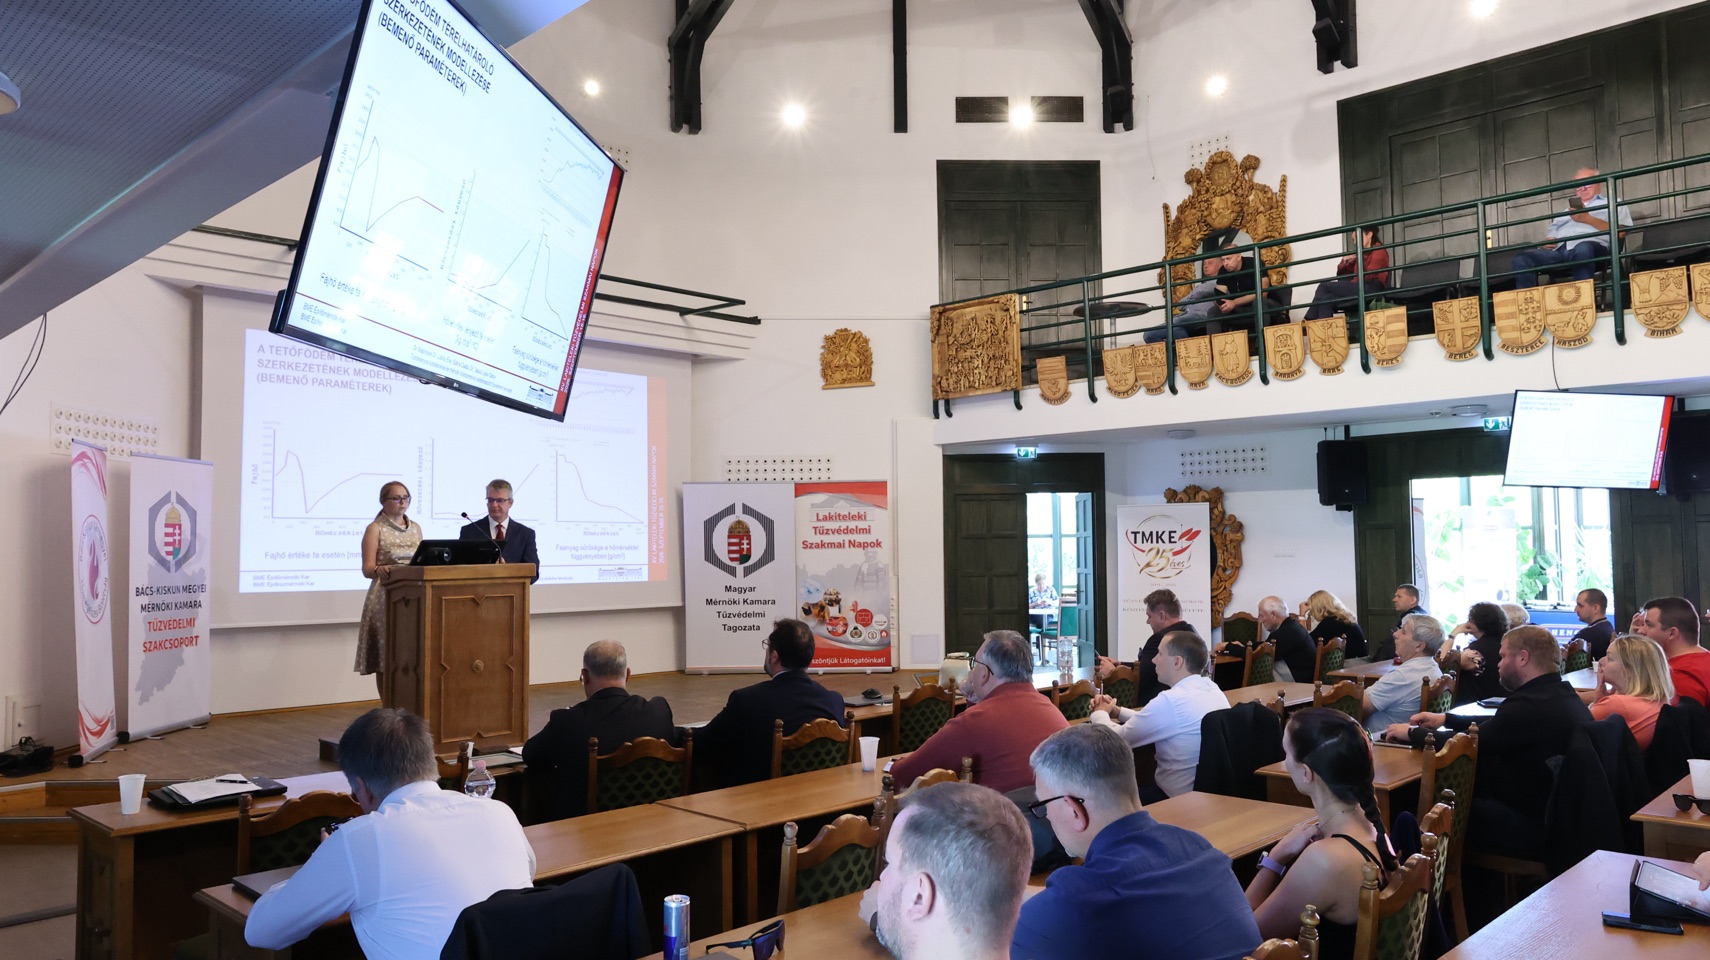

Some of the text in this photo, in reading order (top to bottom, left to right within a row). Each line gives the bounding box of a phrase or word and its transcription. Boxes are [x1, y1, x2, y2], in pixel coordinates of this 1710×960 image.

[410, 0, 494, 76] FÖDÉM TÉRELHATÁROLÓ
[378, 11, 467, 96] (BEMENŐ PARAMÉTEREK)
[446, 48, 492, 94] MODELLEZÉSE
[1650, 328, 1677, 336] BIHAR
[1500, 340, 1544, 354] BESZTERCE
[258, 344, 266, 354] A
[268, 344, 336, 362] TETŐFÖDÉM
[258, 359, 350, 376] SZERKEZETÉNEK
[1274, 370, 1302, 378] BARANYA
[256, 372, 392, 394] (BEMENŐ PARAMÉTEREK)
[816, 512, 867, 522] Lakiteleki
[812, 525, 872, 536] Tűzvédelmi
[1131, 530, 1178, 544] TMKE
[556, 544, 578, 552] Faanyag
[802, 540, 882, 550] Szakmai Napok
[264, 552, 286, 560] Fajhő
[1139, 546, 1176, 574] 25
[1169, 558, 1186, 568] éves
[136, 584, 206, 596] BÁCS-KISKUN MEGYEI
[724, 584, 756, 594] Magyar
[140, 600, 202, 613] MÉRNÖKI KAMARA
[706, 598, 776, 606] Mérnöki Kamara
[717, 610, 766, 618] Tűzvédelmi
[148, 618, 196, 632] TŰZVÉDELMI
[722, 623, 760, 632] Tagozata
[142, 636, 200, 652] SZAKCSOPORT
[840, 656, 886, 664] Látogatóinkat!
